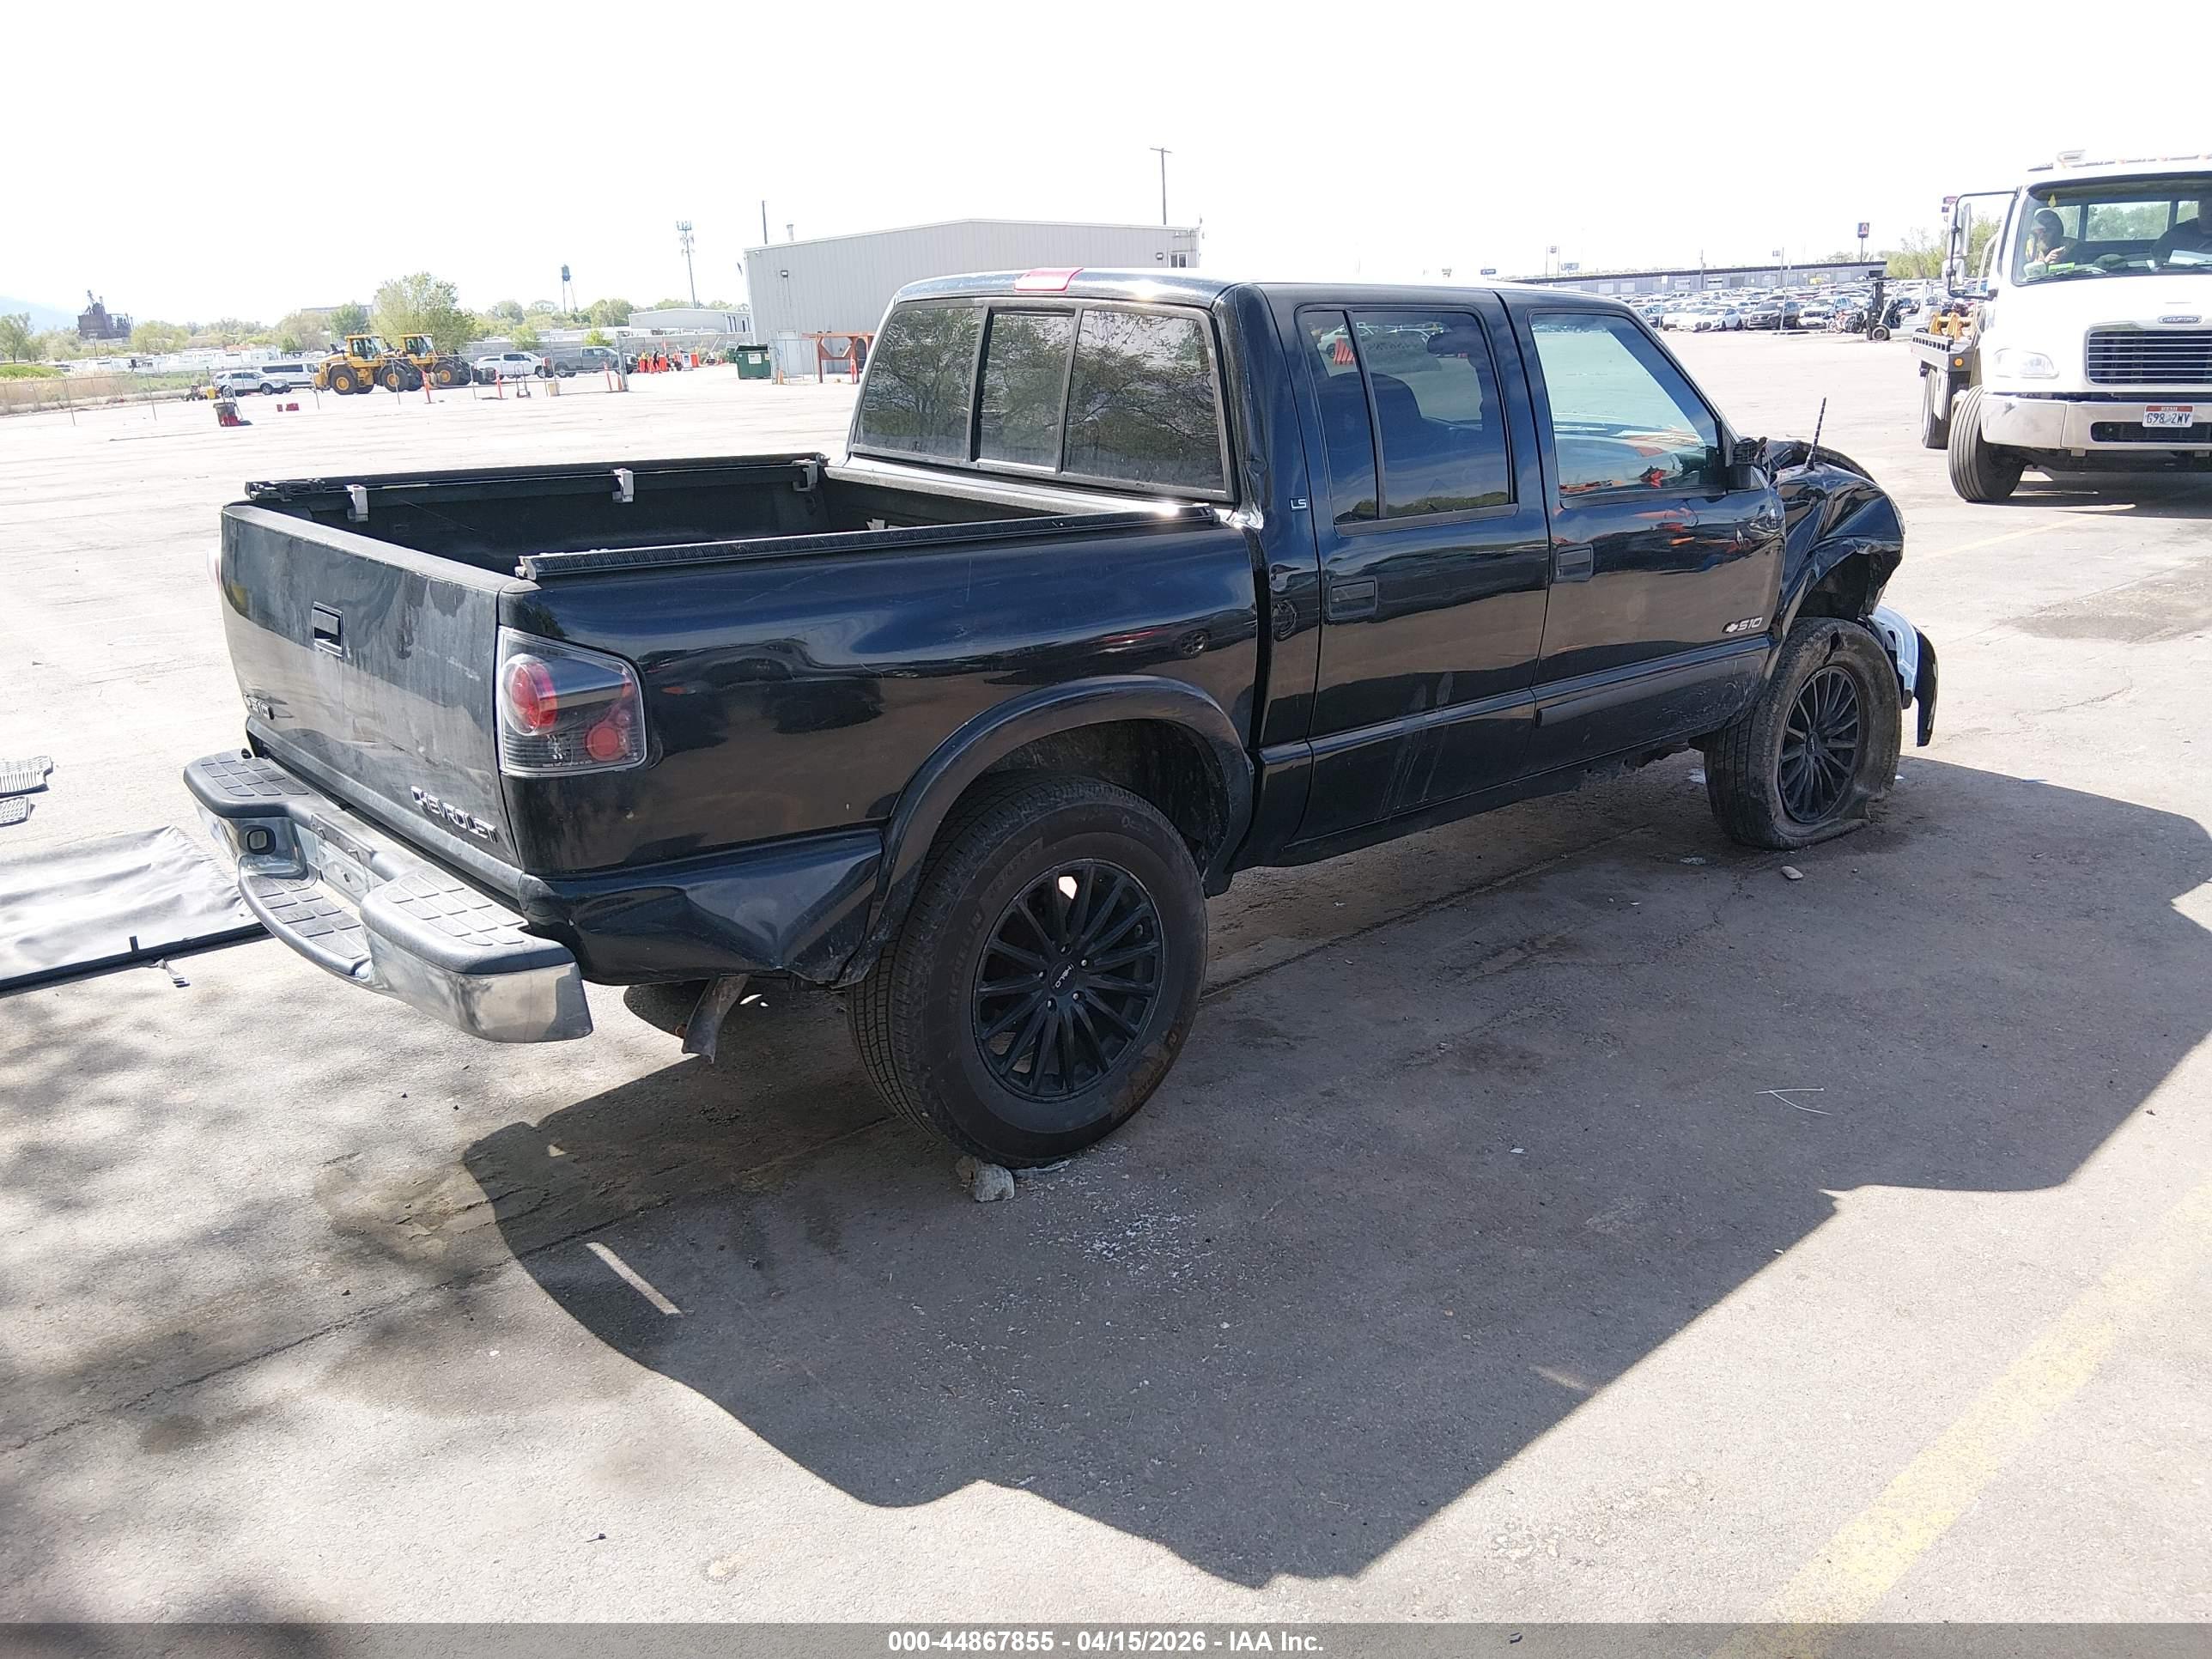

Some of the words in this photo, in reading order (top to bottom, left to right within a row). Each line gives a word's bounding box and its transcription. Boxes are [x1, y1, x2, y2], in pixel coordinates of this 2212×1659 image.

[1291, 499, 1306, 509] LS
[1736, 617, 1763, 632] S10
[410, 785, 498, 843] CHEVROLET
